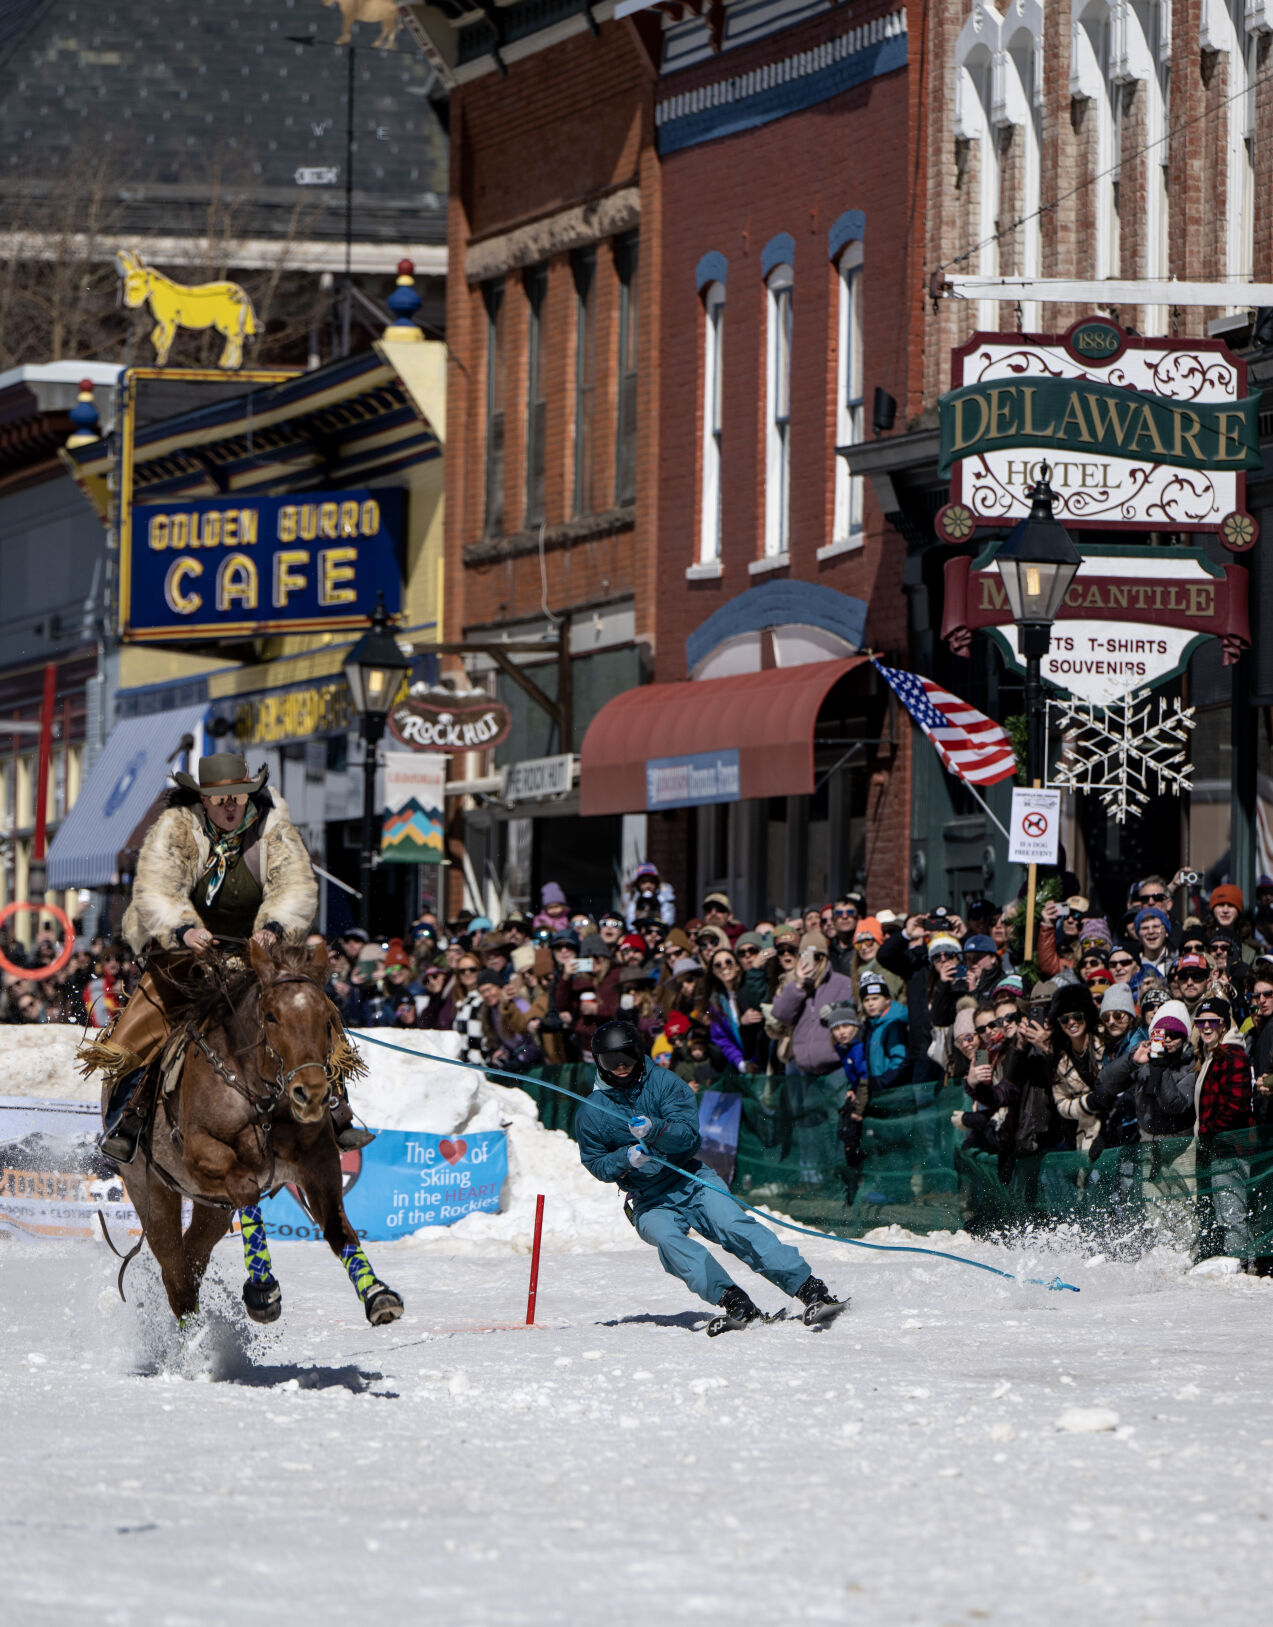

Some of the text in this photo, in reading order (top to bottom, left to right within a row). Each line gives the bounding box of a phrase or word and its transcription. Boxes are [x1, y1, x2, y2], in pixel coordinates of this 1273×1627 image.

[1077, 331, 1118, 351] 1886
[949, 386, 1248, 462] DELAWARE
[1004, 460, 1122, 489] HOTEL
[148, 499, 380, 551] GOLDEN BURRO
[164, 546, 358, 615] CAFE
[978, 578, 1215, 617] MCANTILE
[1049, 637, 1168, 655] TS T-SHIRTS
[400, 712, 499, 747] ROCK HUT
[405, 1141, 489, 1165] The of
[420, 1168, 472, 1189] Skiing
[386, 1194, 500, 1227] of the Rockies
[393, 1183, 498, 1207] in the HEART
